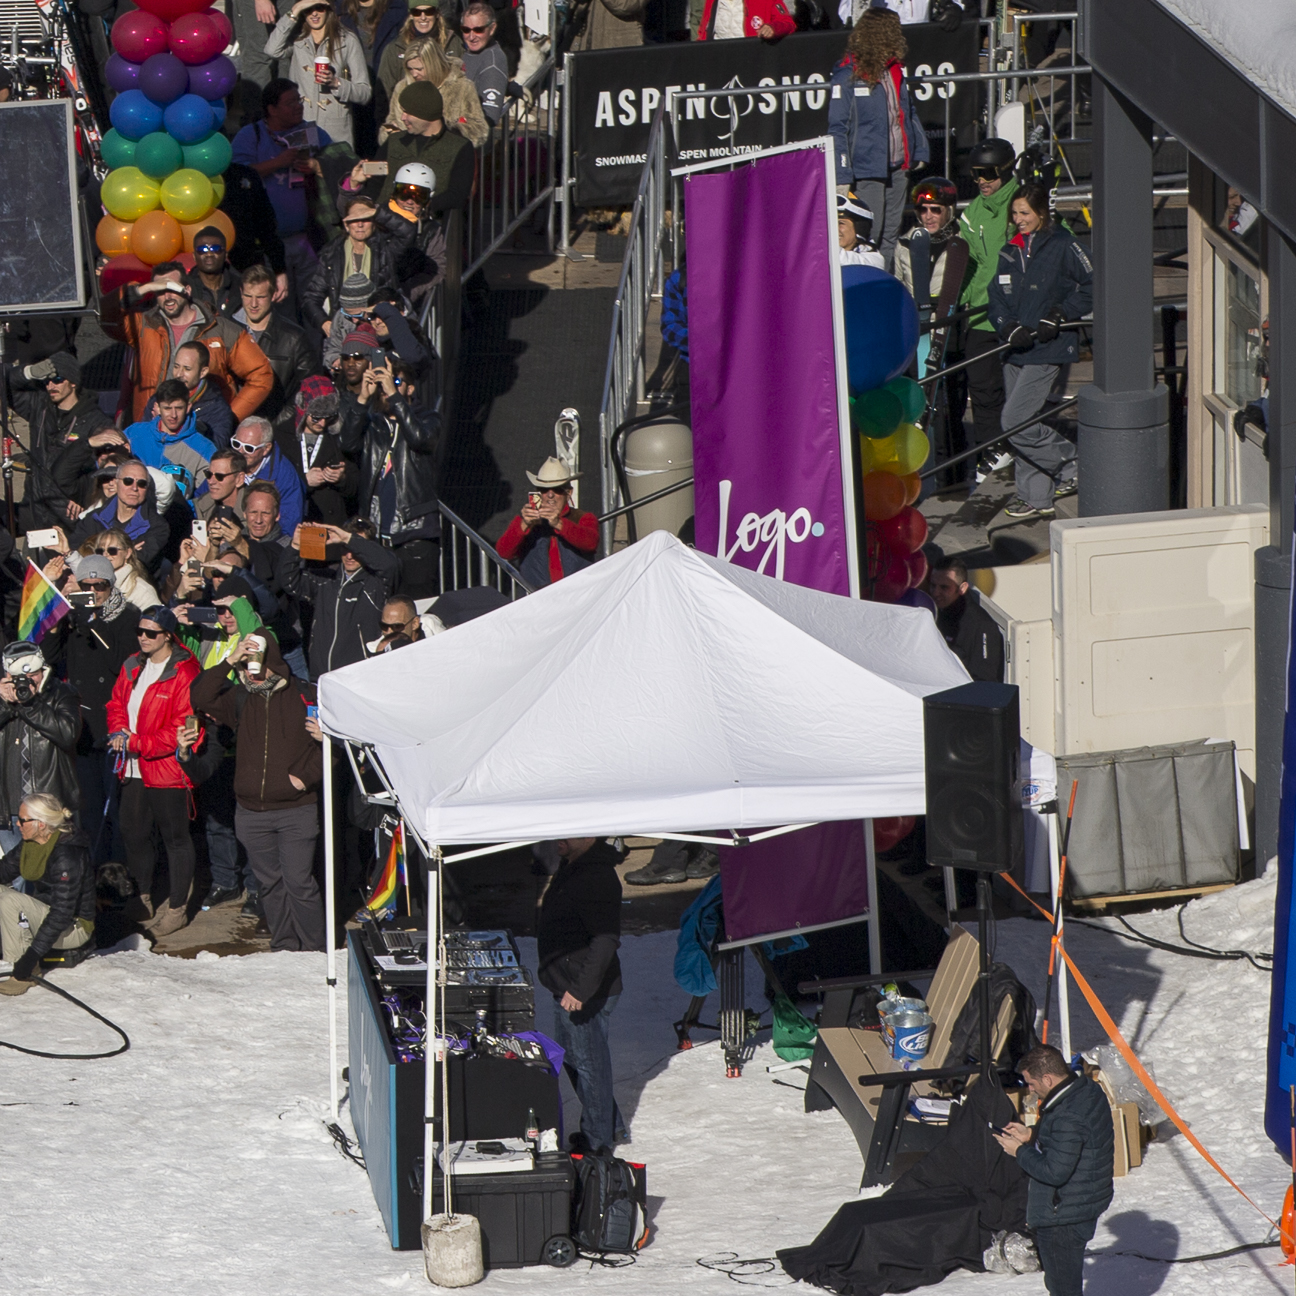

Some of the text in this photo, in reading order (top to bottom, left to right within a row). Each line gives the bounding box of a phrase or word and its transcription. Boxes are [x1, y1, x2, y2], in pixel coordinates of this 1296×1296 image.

[594, 61, 956, 128] ASPEN SNOSS
[595, 153, 648, 167] SNOWMAS
[678, 149, 707, 160] SPEN
